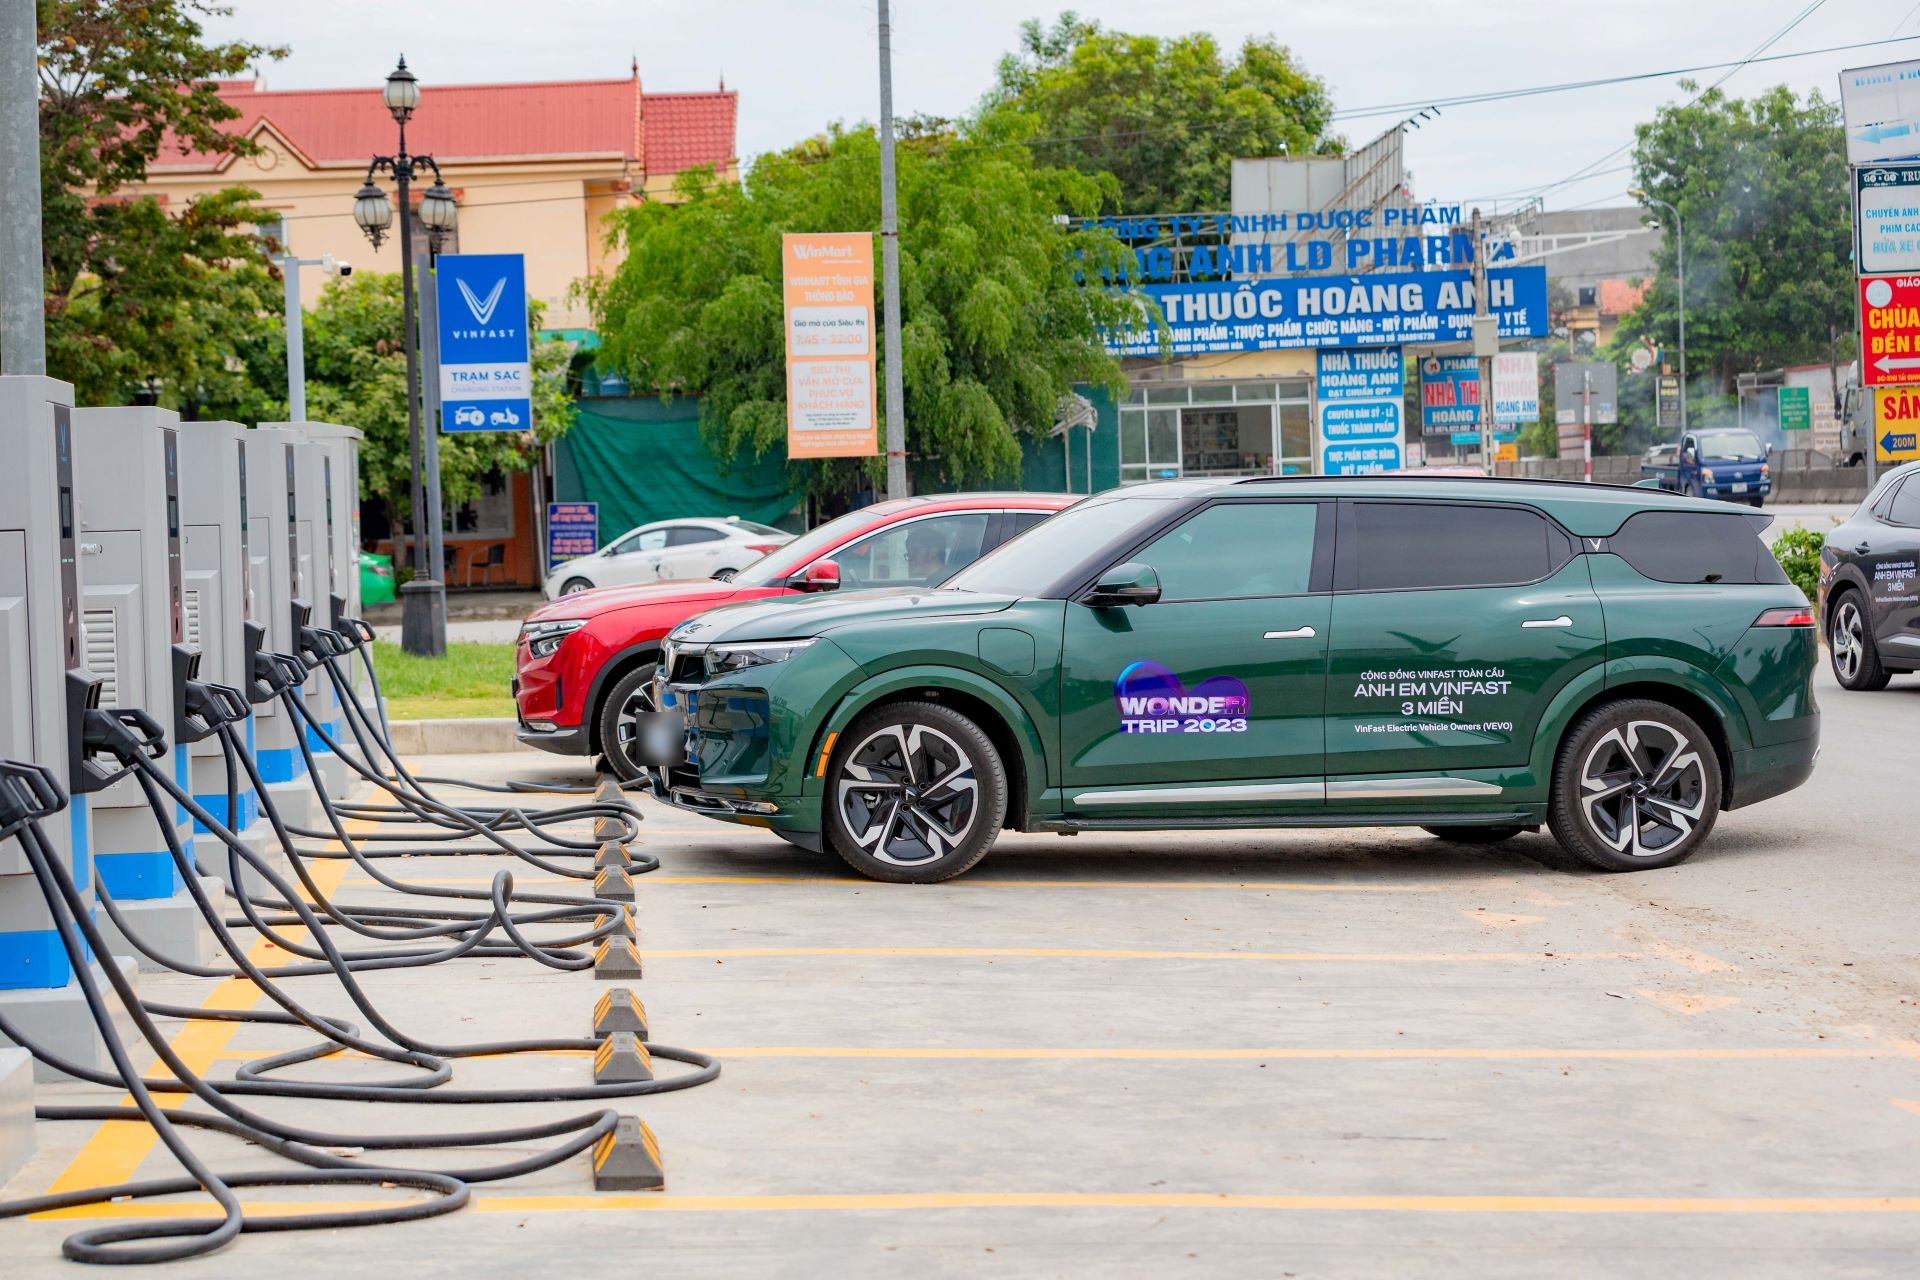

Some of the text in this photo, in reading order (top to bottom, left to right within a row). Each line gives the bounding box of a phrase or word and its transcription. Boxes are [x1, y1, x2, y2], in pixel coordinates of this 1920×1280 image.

[1168, 215, 1204, 237] TY
[1211, 213, 1287, 234] TNHH
[1297, 207, 1372, 234] DƯỢC
[1384, 198, 1461, 226] PHẨM
[1880, 224, 1902, 233] PHIM
[1189, 244, 1272, 277] ANH
[1286, 240, 1332, 271] LD
[1896, 276, 1920, 288] GIÁO
[1161, 279, 1282, 322] THUỐC
[1298, 278, 1423, 316] HOÀNG
[1193, 322, 1228, 341] PHẨM
[1267, 318, 1302, 337] PHẨM
[1306, 318, 1338, 335] CHỨC
[1340, 316, 1374, 334] NĂNG
[1403, 312, 1438, 331] PHẨM
[1512, 307, 1527, 325] TẾ
[1868, 303, 1920, 329] CHÙA
[453, 329, 515, 339] VINFAST
[1322, 347, 1398, 371] NHÀ THUỐC
[1321, 372, 1399, 387] HOÀNG ANH
[1424, 375, 1457, 406] NHÀ
[1884, 389, 1920, 420] SÂN
[1432, 408, 1474, 423] HOÀNG
[1892, 436, 1915, 448] 200M
[1361, 667, 1505, 682] CỘNG ĐỒNG VINFAST TOÀN CẦU
[1354, 681, 1511, 697] ANH EM VINFAST
[1120, 696, 1246, 715] WONDER
[1402, 696, 1463, 715] 3 MIỀN
[1121, 718, 1248, 733] TRIP 2023
[1354, 722, 1513, 733] VinFast Electric Vehicle Owners (VEVO)
